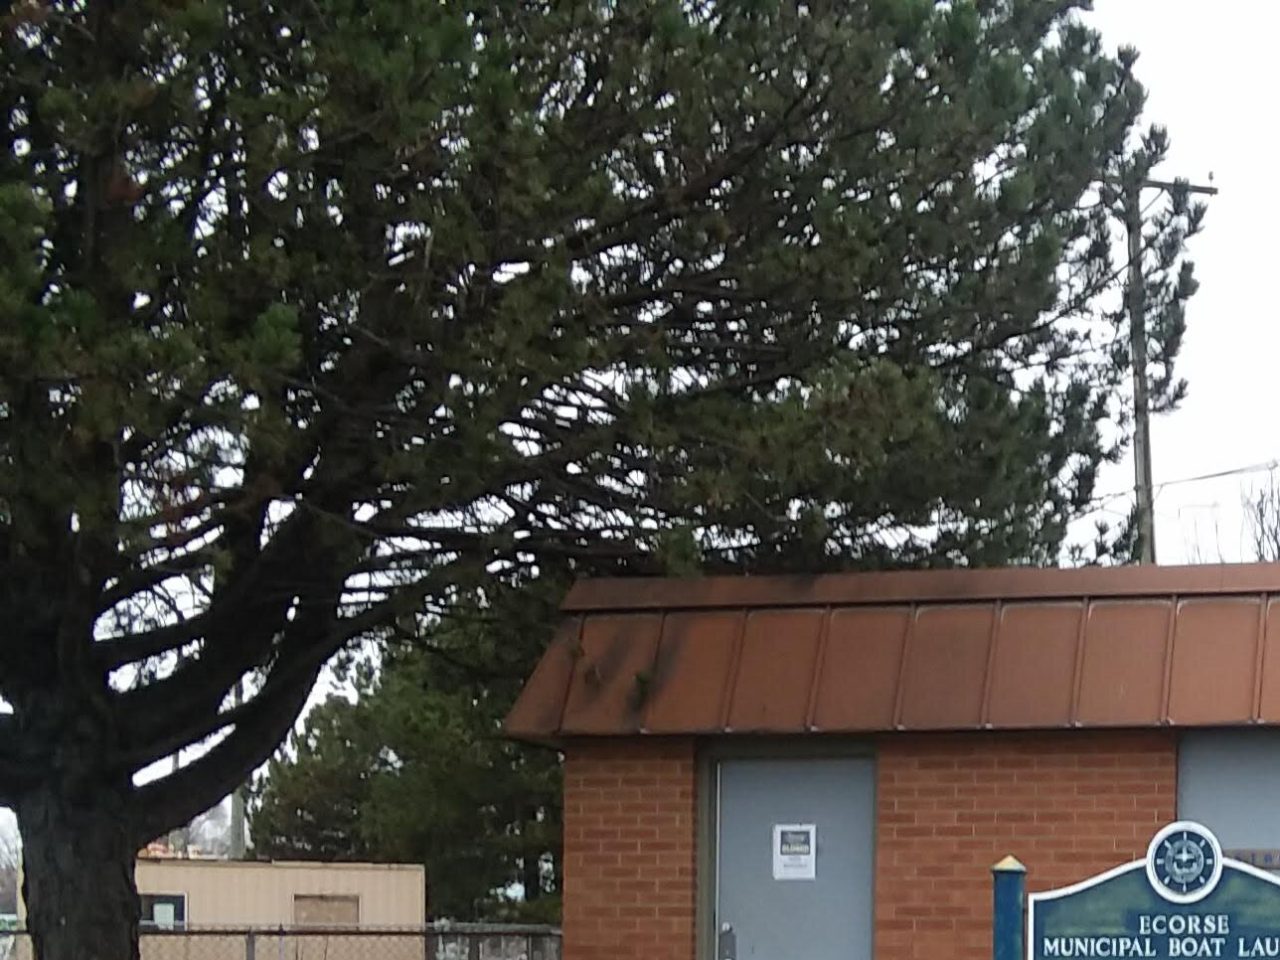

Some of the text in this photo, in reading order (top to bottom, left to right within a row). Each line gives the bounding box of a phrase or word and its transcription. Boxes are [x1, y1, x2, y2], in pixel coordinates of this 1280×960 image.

[1139, 914, 1230, 935] ECORSE
[1043, 937, 1157, 957] MUNICIPAL
[1168, 937, 1226, 957] BOAT
